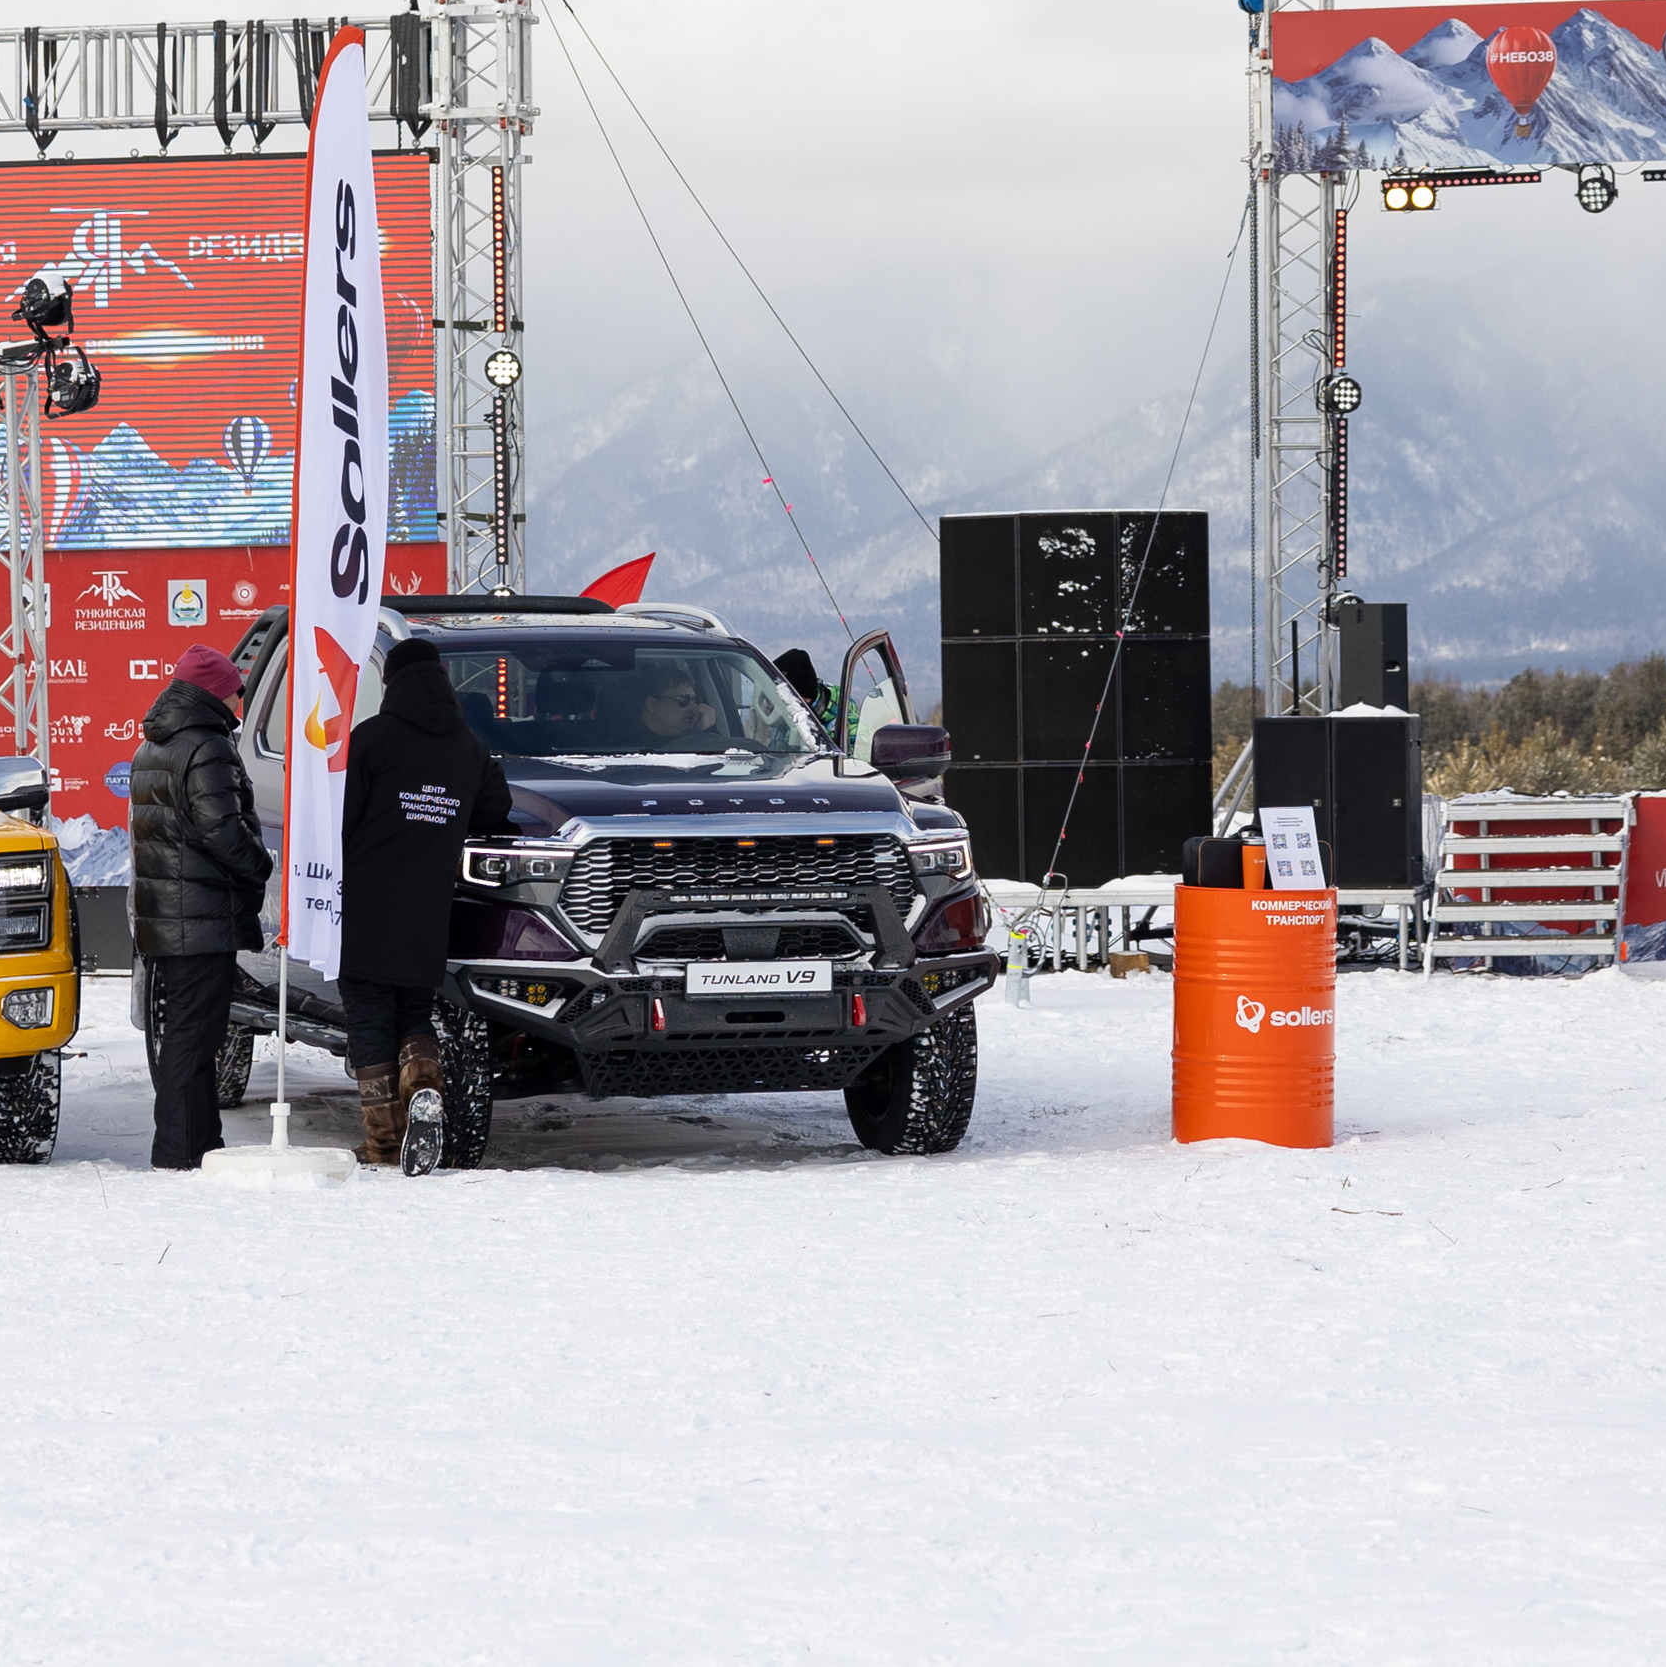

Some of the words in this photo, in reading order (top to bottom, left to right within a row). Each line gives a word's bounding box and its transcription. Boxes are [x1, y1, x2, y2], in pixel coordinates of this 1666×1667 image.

[1490, 51, 1555, 64] #НЕБО38
[74, 607, 146, 619] ТУНКИНСКАЯ
[75, 619, 145, 631] РЕЗИДЕНЦИЯ
[422, 785, 446, 794] ЦЕНТР
[399, 792, 461, 807] КОММЕРЧЕСКОГО
[401, 802, 447, 815] ТРАНСПОРТА
[406, 812, 447, 824] ШИРЯМОВА
[1251, 898, 1332, 911] КОММЕРЧЕСКИЙ
[1265, 915, 1325, 925] ТРАНСПОРТ
[701, 974, 780, 985] TUNLAND
[786, 970, 816, 984] V9
[1270, 1006, 1333, 1027] sollers
